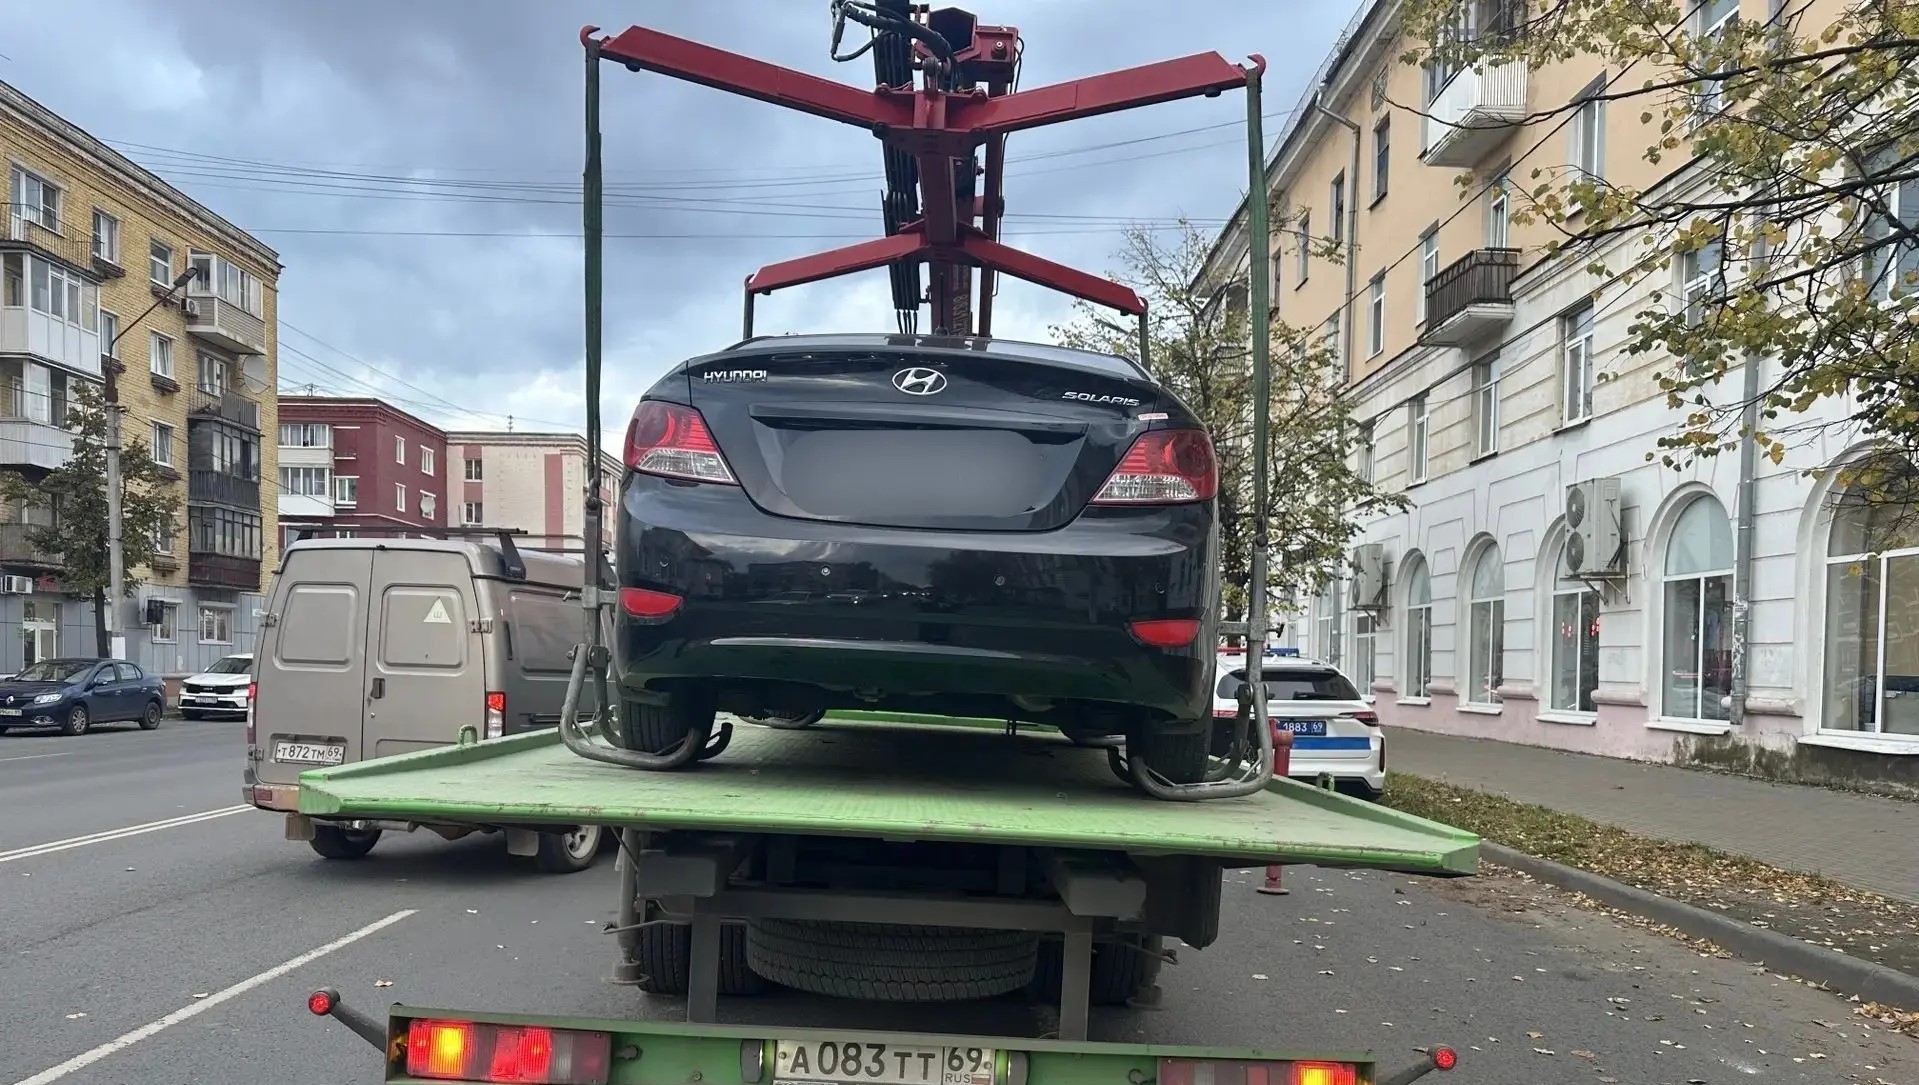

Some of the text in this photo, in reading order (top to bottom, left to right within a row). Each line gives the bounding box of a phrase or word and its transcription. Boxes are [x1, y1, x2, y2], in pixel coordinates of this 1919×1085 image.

[703, 370, 767, 384] HYUNDAI
[1061, 391, 1140, 406] SOLARIS
[327, 746, 340, 757] 69
[947, 1048, 983, 1072] 69
[945, 1073, 970, 1084] RUS
